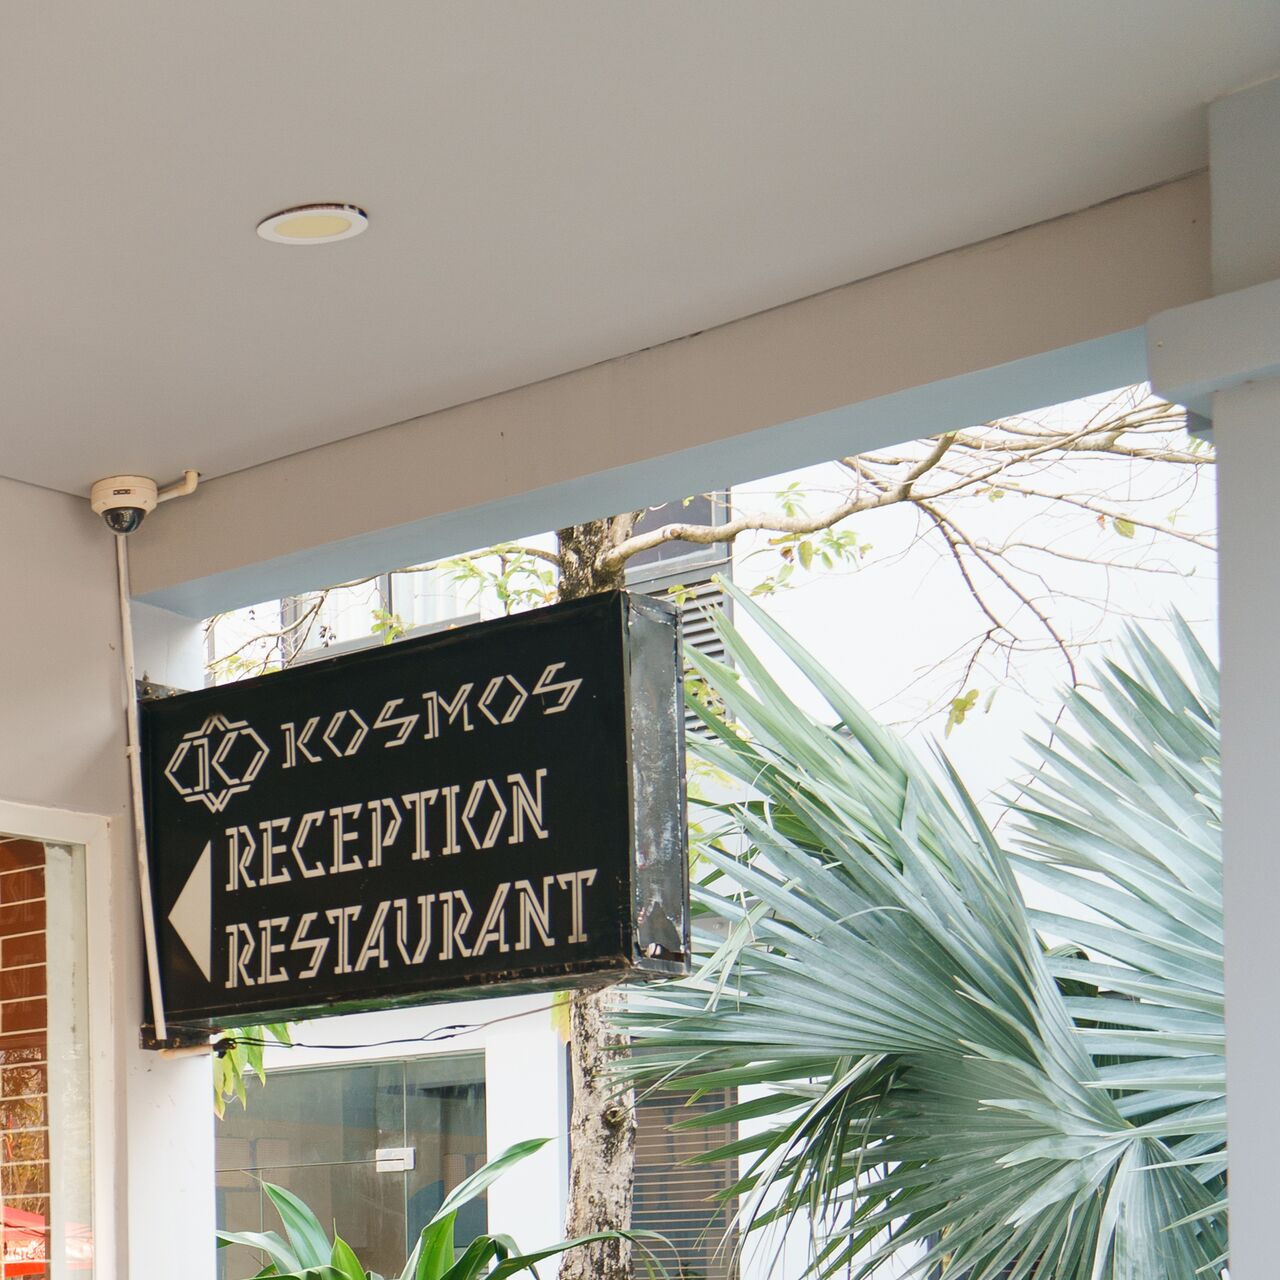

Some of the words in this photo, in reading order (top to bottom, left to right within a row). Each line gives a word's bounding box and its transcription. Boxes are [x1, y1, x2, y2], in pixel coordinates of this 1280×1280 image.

[281, 661, 583, 769] KOSMOS
[225, 768, 549, 892] RECEPTION
[225, 868, 598, 990] RESTAURANT
